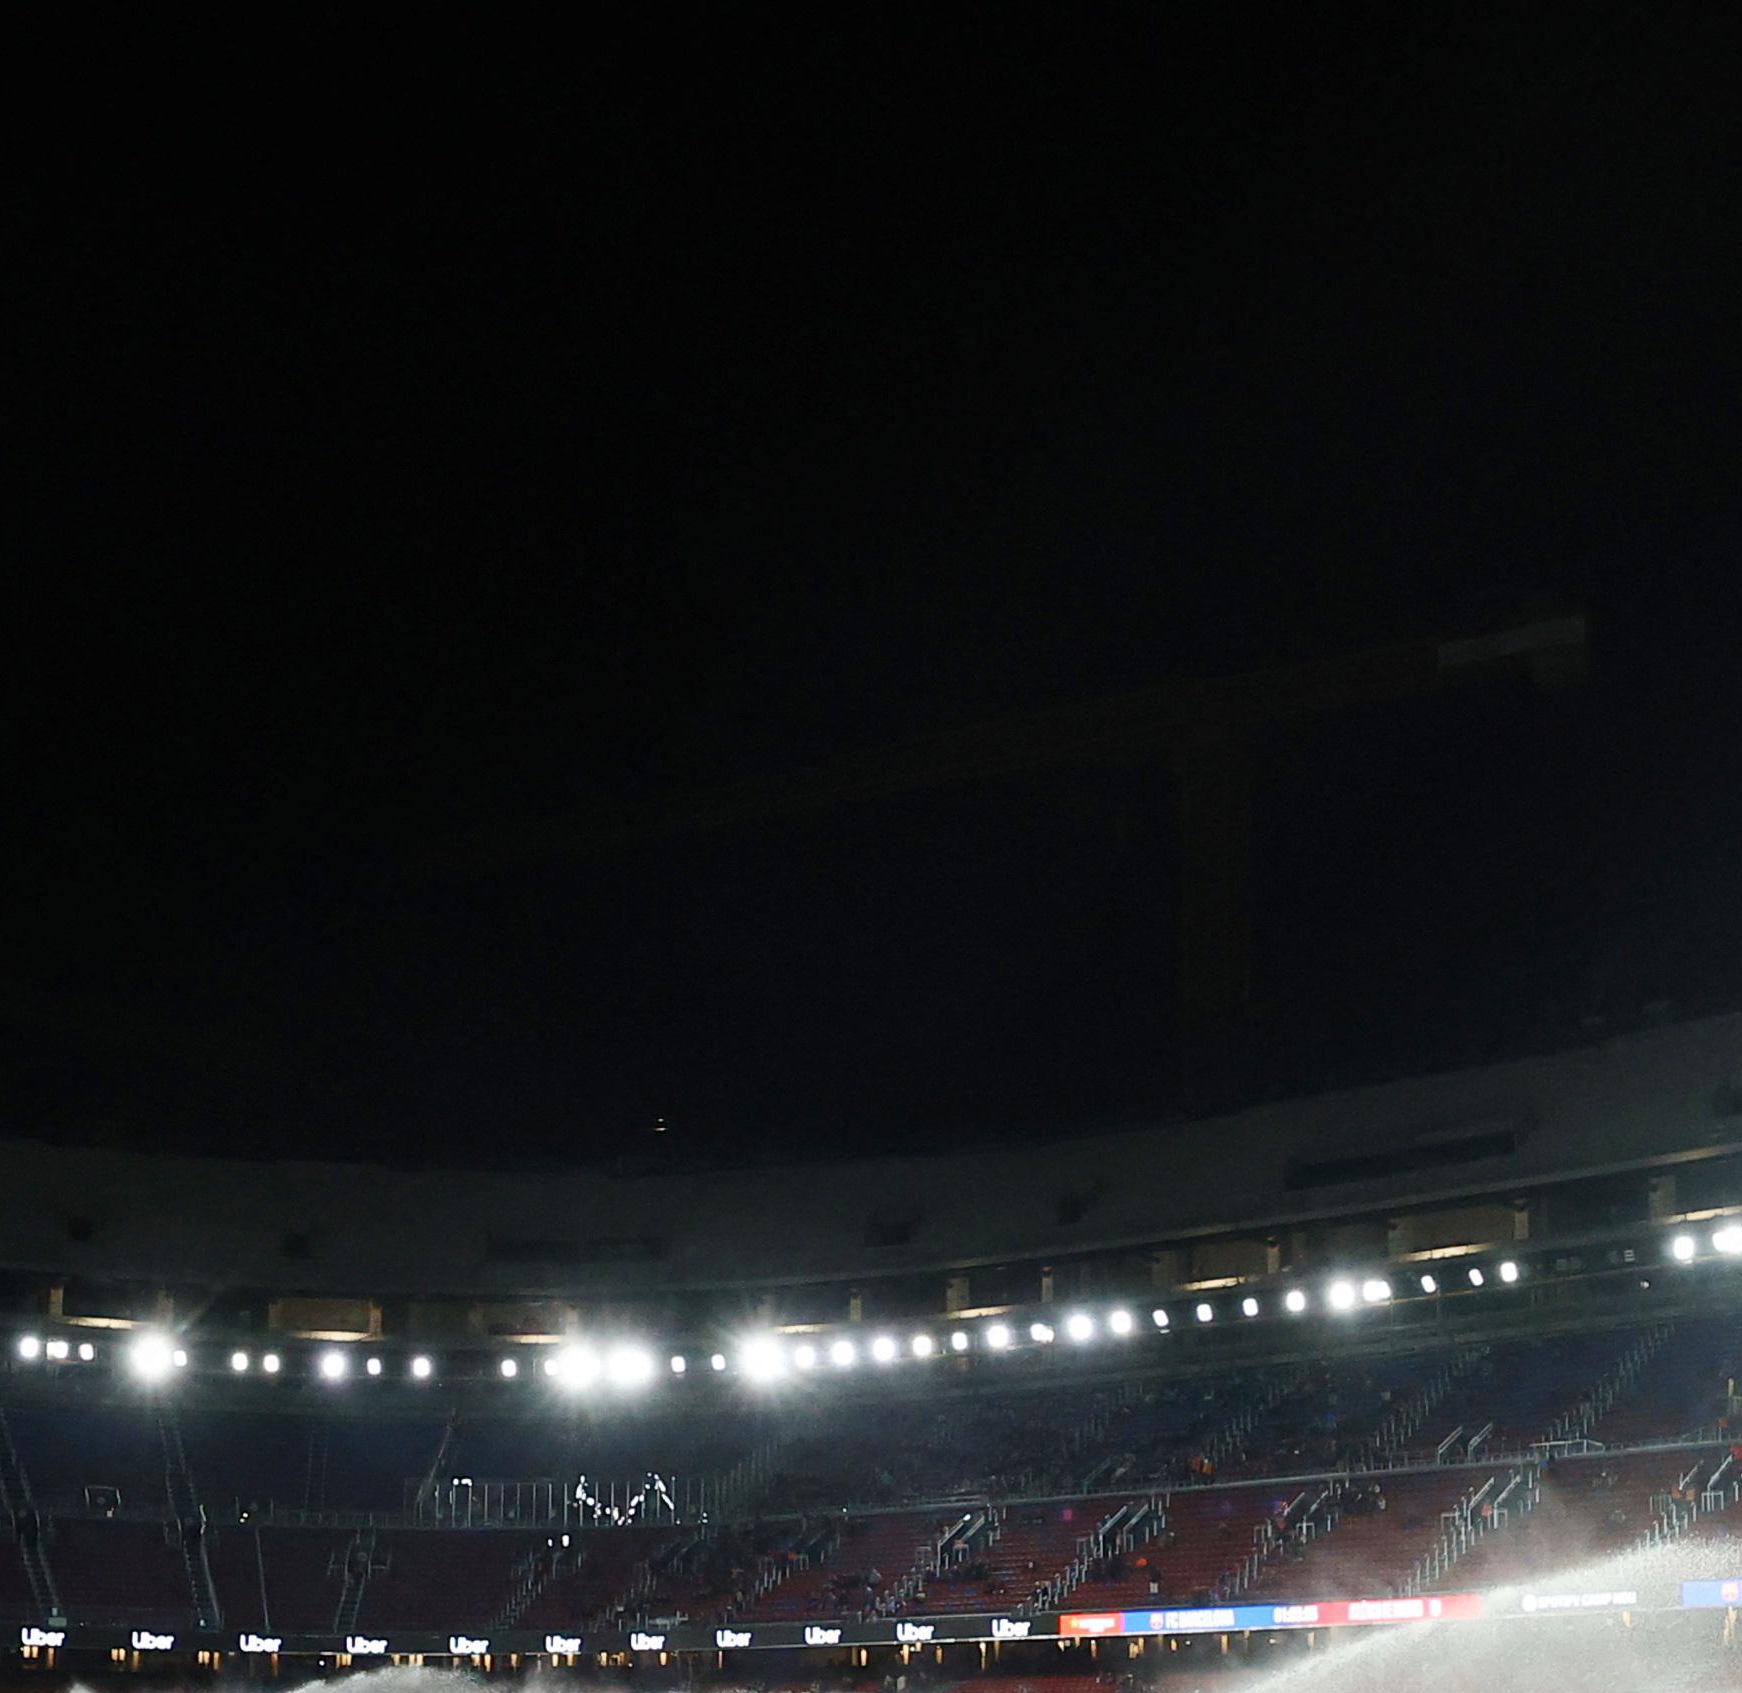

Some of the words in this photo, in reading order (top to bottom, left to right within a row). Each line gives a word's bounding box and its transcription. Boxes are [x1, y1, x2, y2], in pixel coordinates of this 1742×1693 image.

[805, 1627, 841, 1645] Uber
[897, 1623, 933, 1641] Uber
[993, 1619, 1030, 1637] Uber
[22, 1628, 65, 1646] Uber
[132, 1632, 174, 1649] Uber
[240, 1635, 281, 1652] Uber
[346, 1637, 387, 1654] Uber
[450, 1637, 489, 1654] Uber
[546, 1636, 581, 1652] Uber
[631, 1633, 665, 1650] Uber
[717, 1630, 751, 1647] Uber
